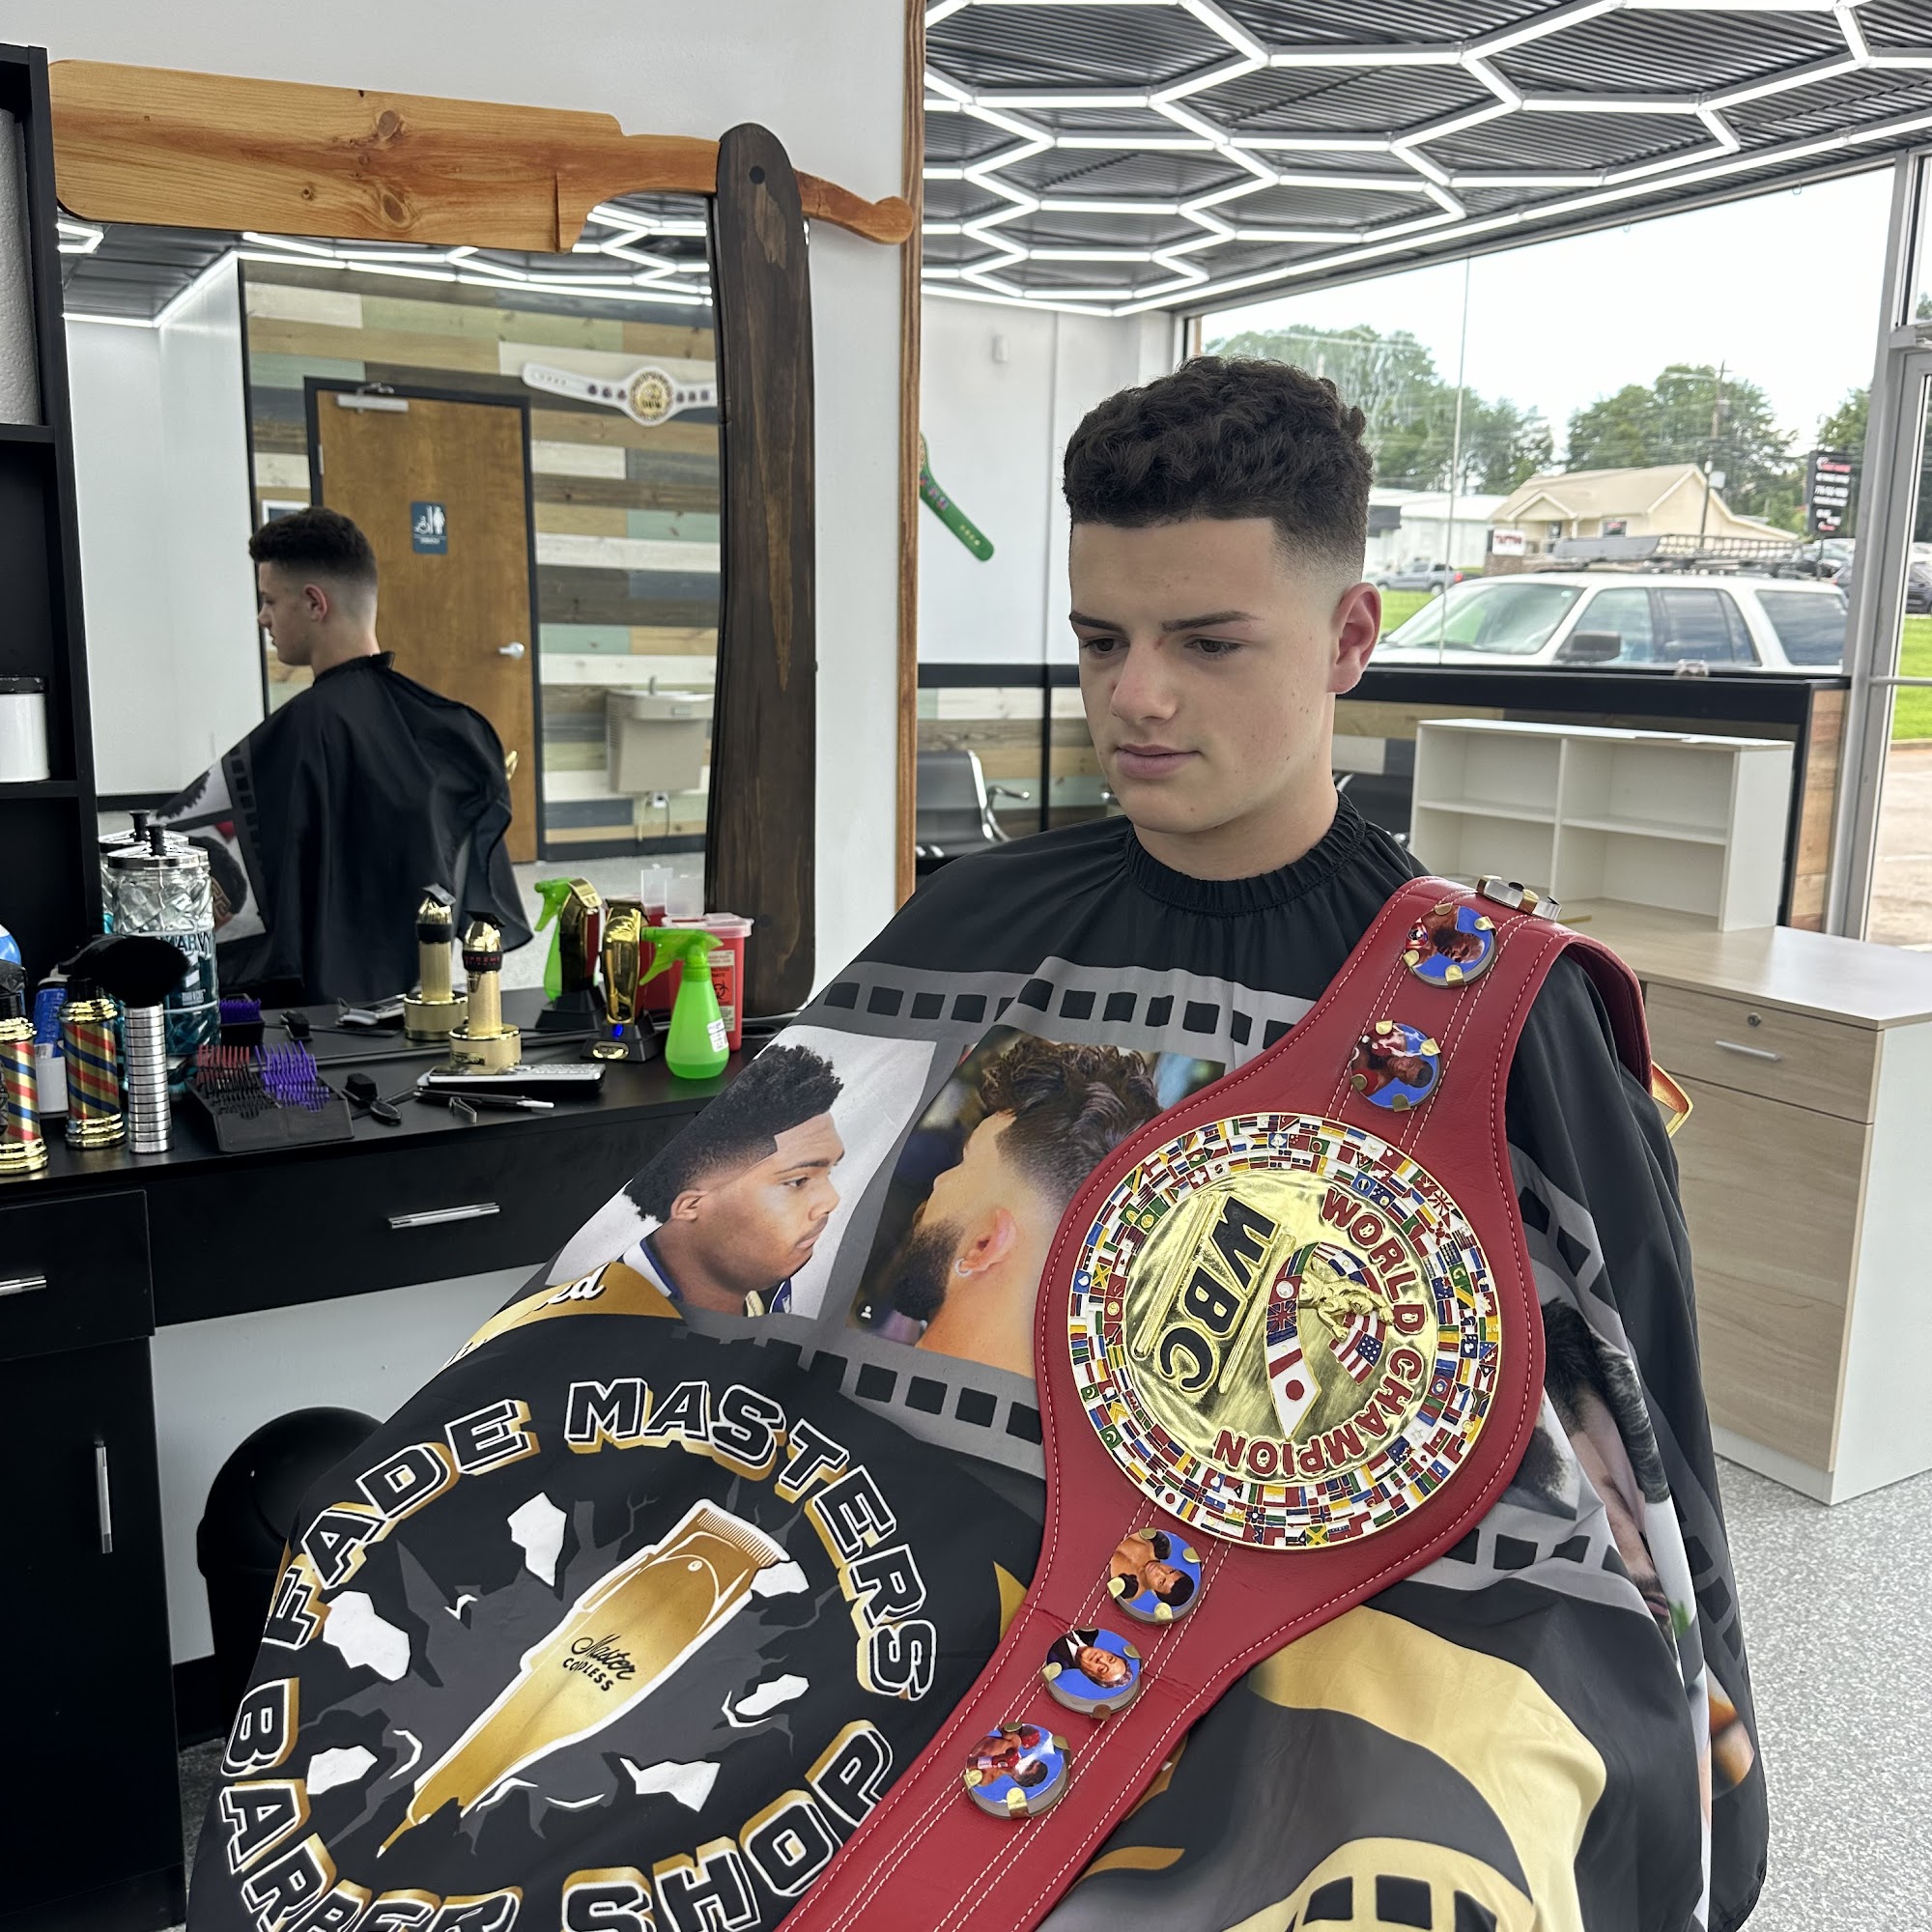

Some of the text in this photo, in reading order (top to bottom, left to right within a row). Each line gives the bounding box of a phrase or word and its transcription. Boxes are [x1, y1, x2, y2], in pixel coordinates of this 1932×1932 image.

[1157, 1194, 1279, 1392] WBC
[1213, 1188, 1428, 1478] WORLD CHAMPION
[262, 1378, 938, 1701] FADE MASTERS
[571, 1633, 636, 1680] Master
[562, 1719, 894, 1932] SHOP
